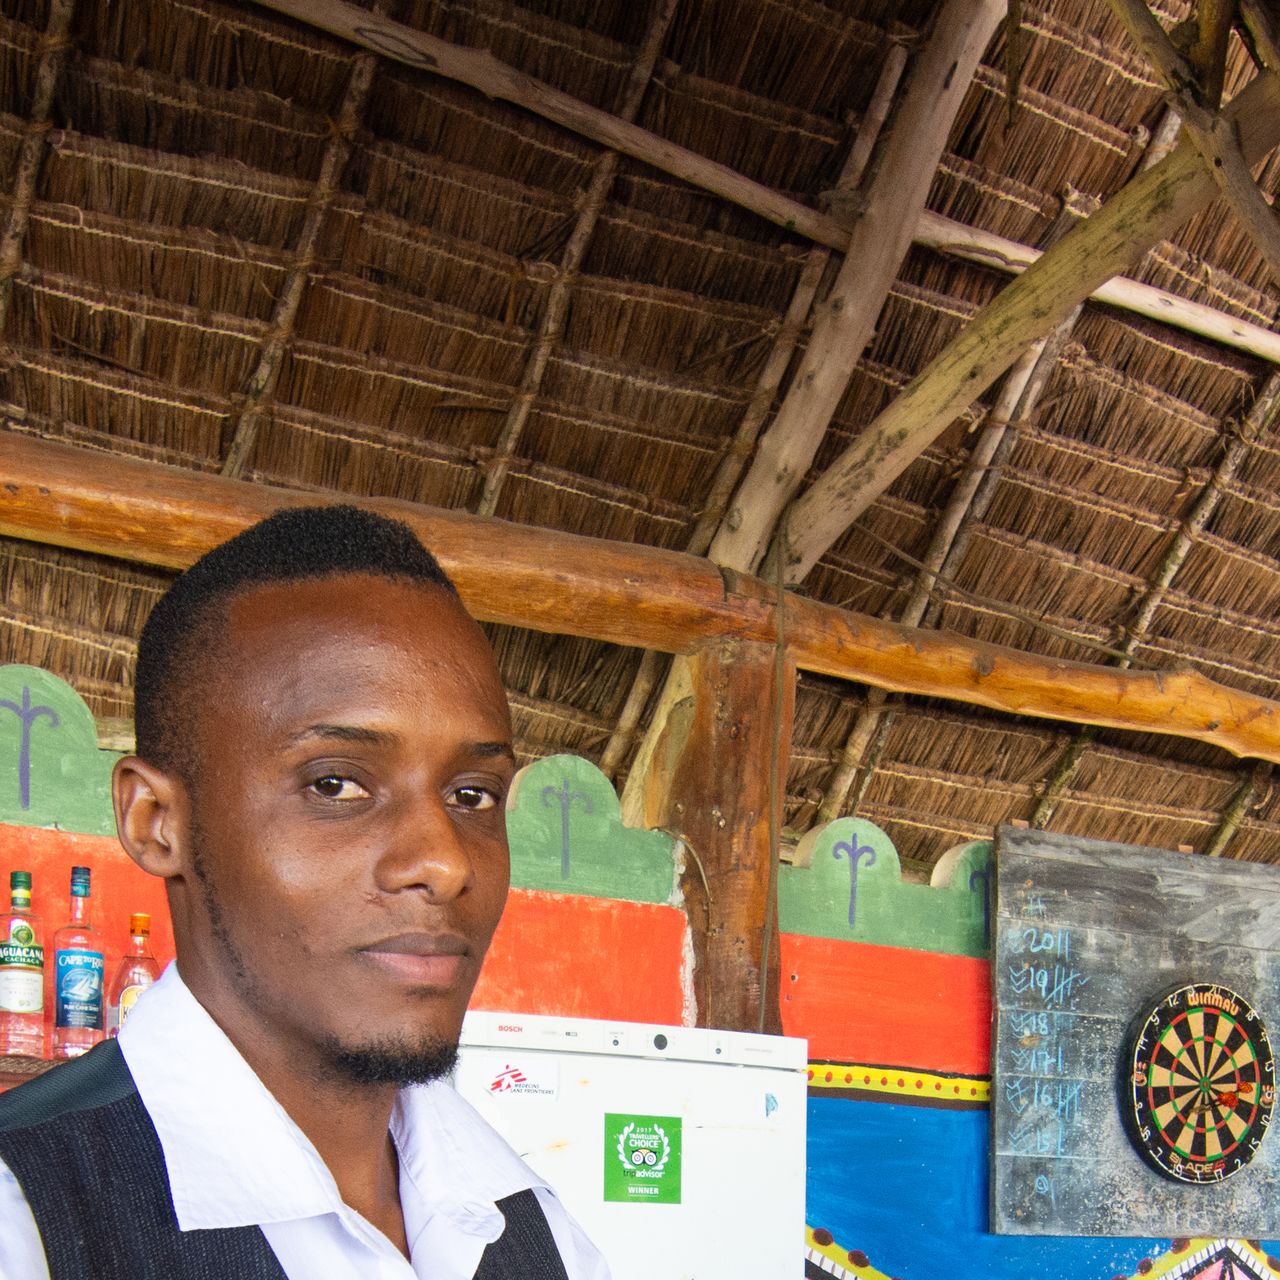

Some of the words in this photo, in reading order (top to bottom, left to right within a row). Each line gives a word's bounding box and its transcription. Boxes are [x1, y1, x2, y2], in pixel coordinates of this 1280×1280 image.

[1187, 991, 1239, 1016] WINMAU
[498, 1024, 523, 1033] BOSCH
[628, 1139, 659, 1148] CHOICE
[623, 1168, 663, 1179] tripadvisor
[628, 1186, 660, 1195] WINNER
